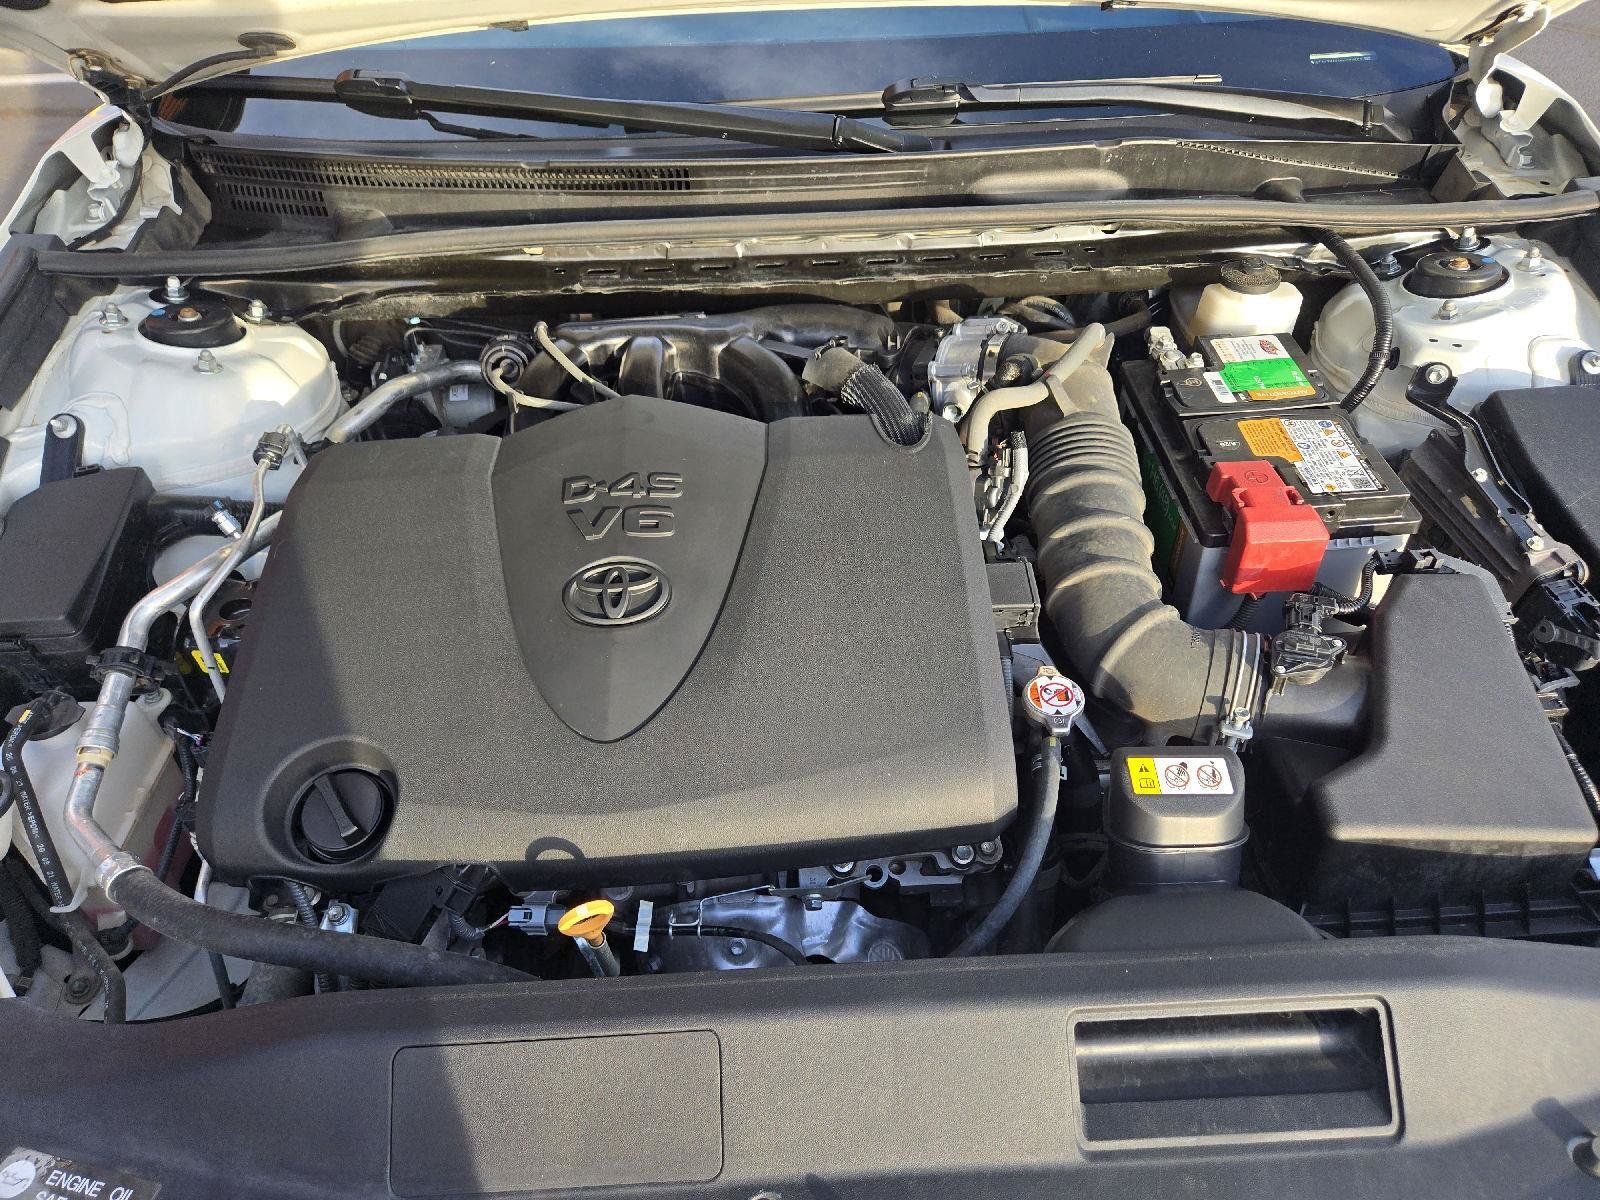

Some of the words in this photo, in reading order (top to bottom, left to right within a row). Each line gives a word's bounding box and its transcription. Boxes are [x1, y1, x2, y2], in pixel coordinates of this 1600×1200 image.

[562, 471, 684, 504] D-4S
[566, 504, 676, 541] V6
[45, 1169, 106, 1198] ENGINE
